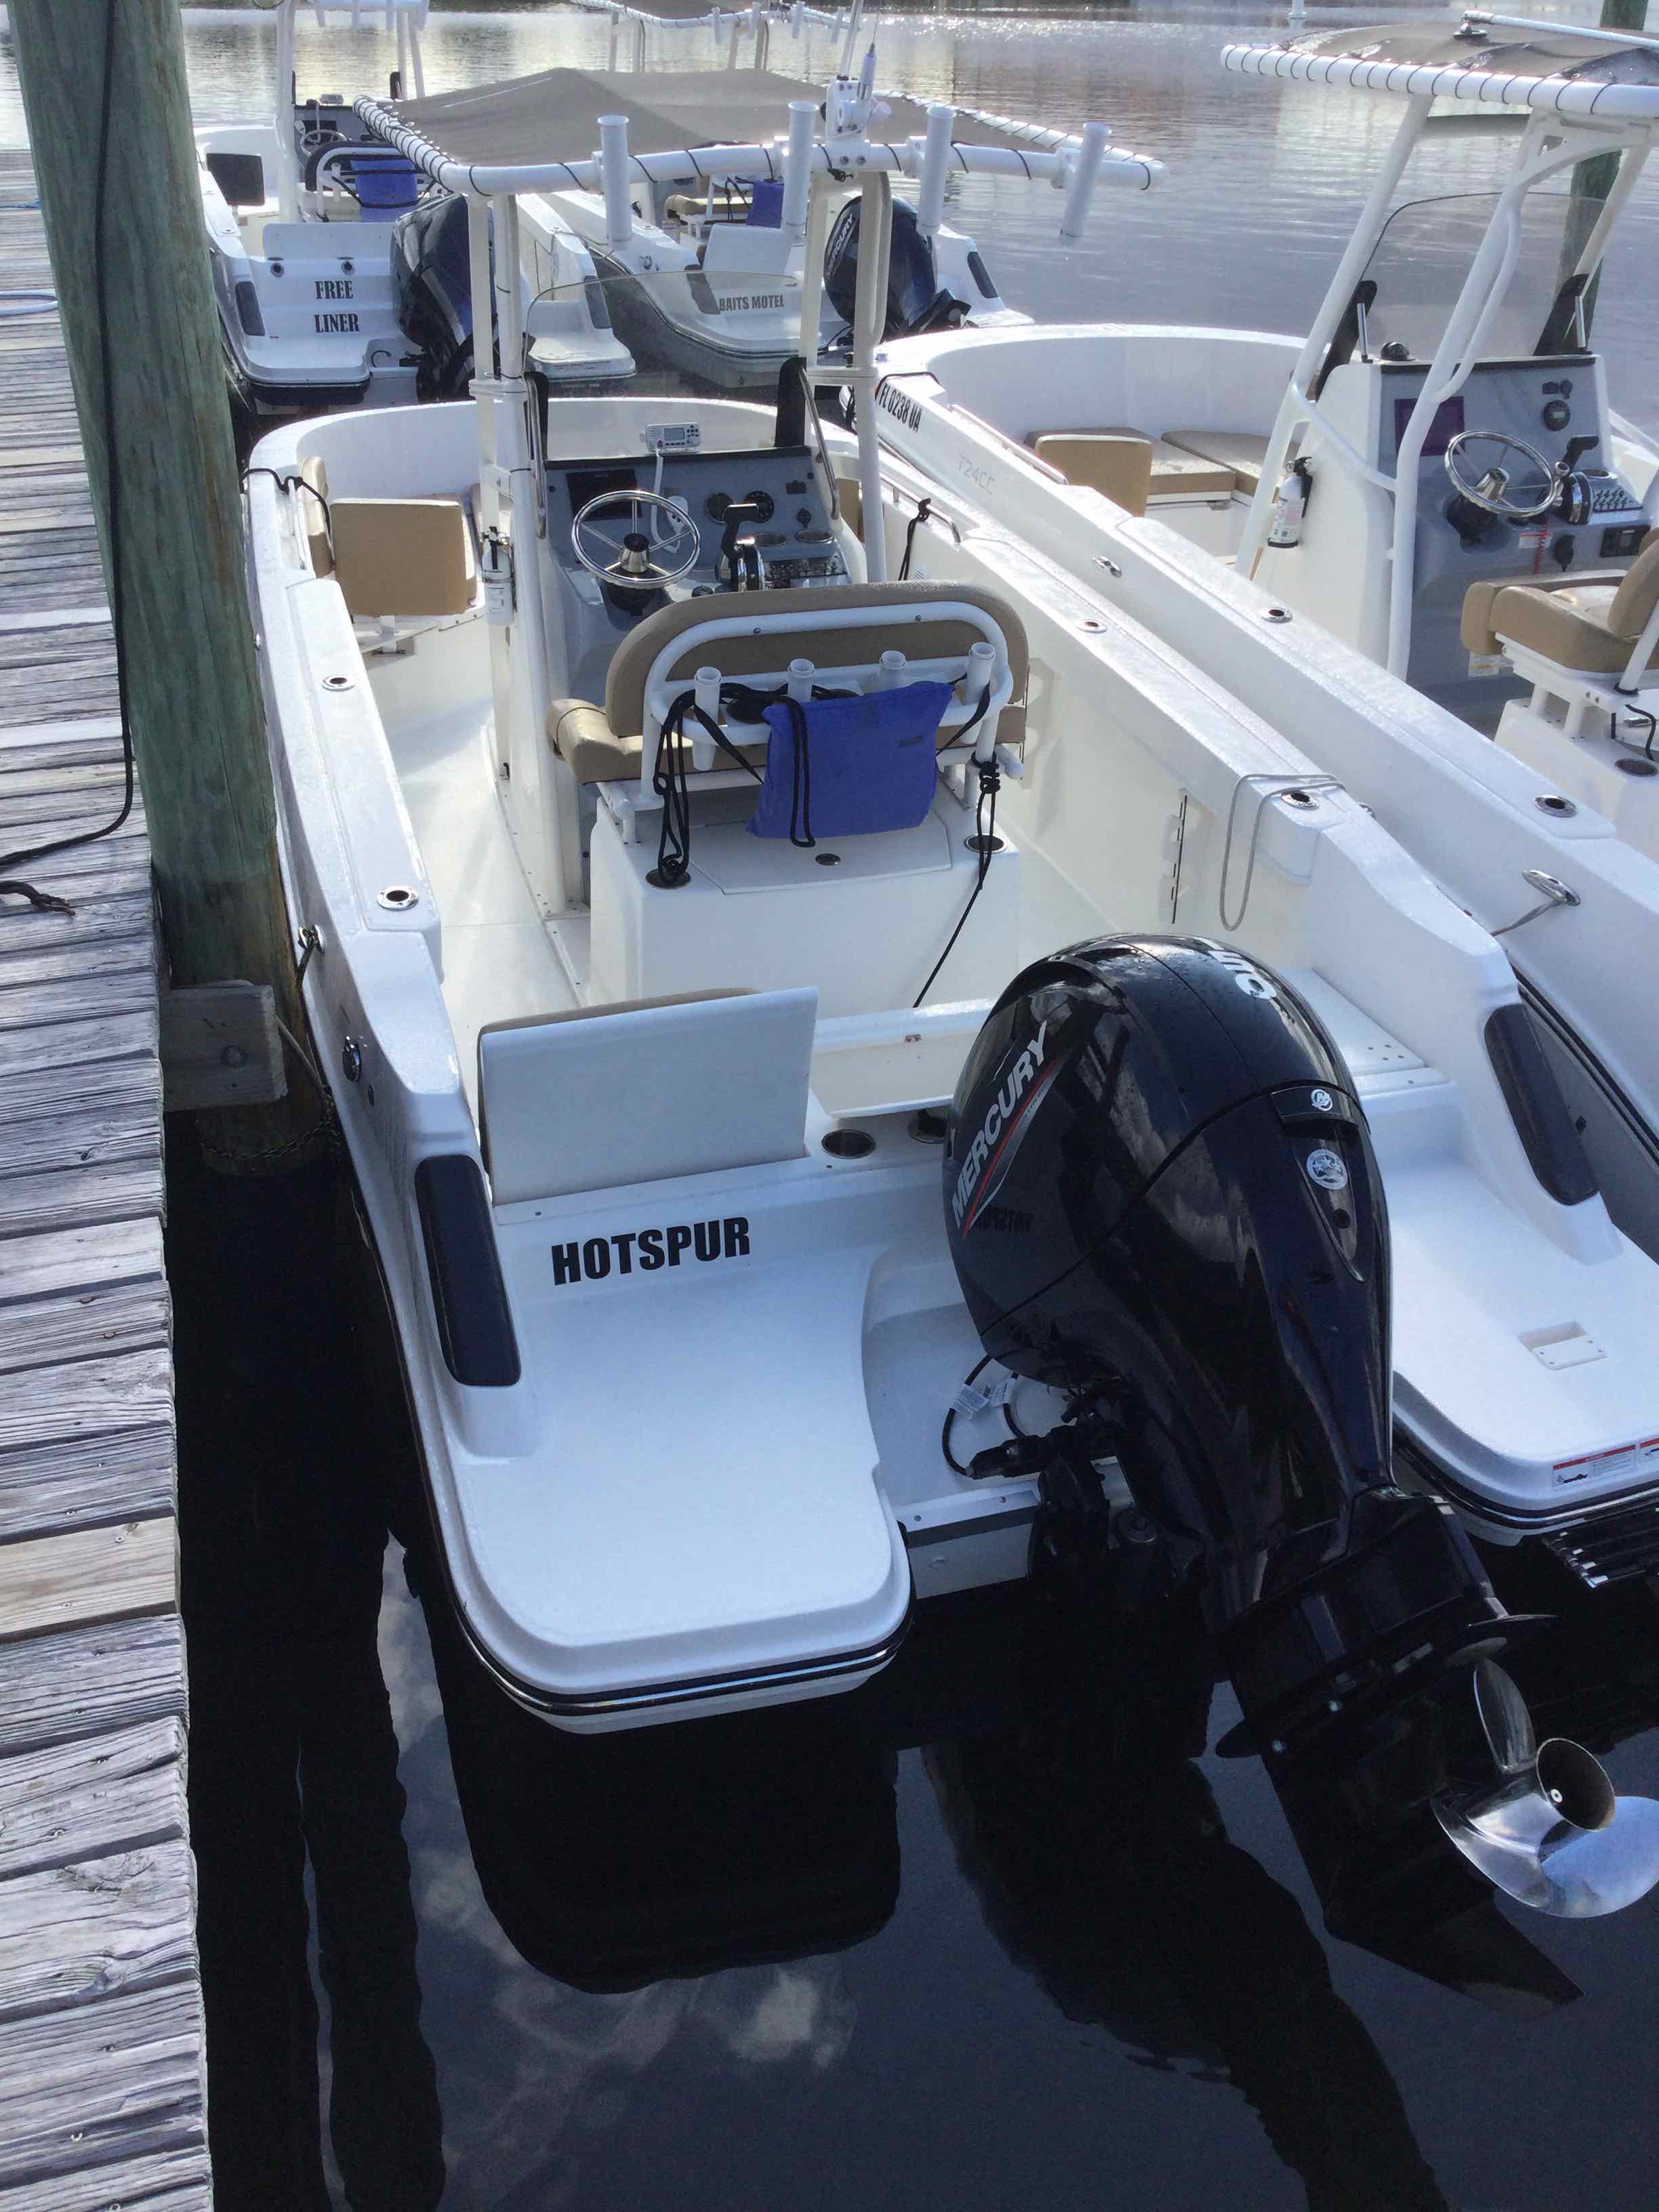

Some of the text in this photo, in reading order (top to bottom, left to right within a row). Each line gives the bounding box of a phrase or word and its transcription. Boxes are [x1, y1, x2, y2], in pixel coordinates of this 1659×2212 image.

[826, 212, 853, 281] RCURY
[314, 280, 354, 299] FREE
[718, 295, 785, 311] BAITS MOTEL
[314, 313, 360, 333] LINER
[879, 383, 922, 433] FL 0238 UA
[950, 1019, 1047, 1229] MERCURY
[550, 1216, 751, 1286] HOTSPUR
